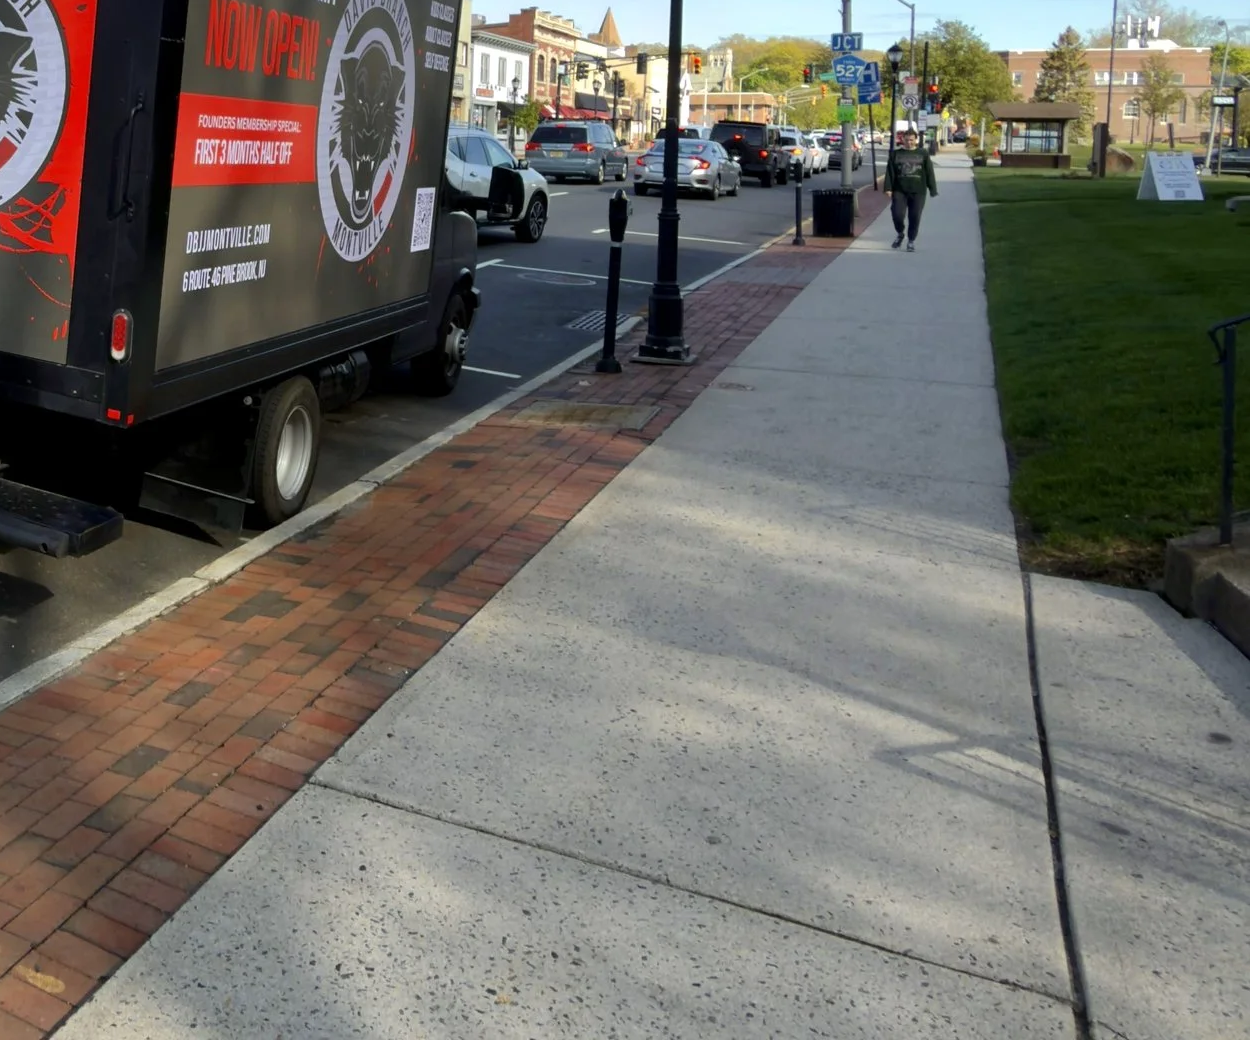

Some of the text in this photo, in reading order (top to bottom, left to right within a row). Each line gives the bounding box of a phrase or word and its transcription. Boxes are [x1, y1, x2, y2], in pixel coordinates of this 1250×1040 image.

[261, 8, 321, 81] OPEN!
[833, 35, 861, 50] JCT
[836, 63, 865, 78] 527
[197, 114, 302, 133] FOUNDERS MEMBERSHIP SPECIAL:
[194, 138, 294, 165] FIRST 3 MONTHS HALF OFF
[185, 223, 271, 254] DBJJMONTVILLE.COM
[331, 210, 384, 257] MONTVILLE
[182, 259, 267, 293] 6 ROUTE 46 PINE BROOK, NJ
